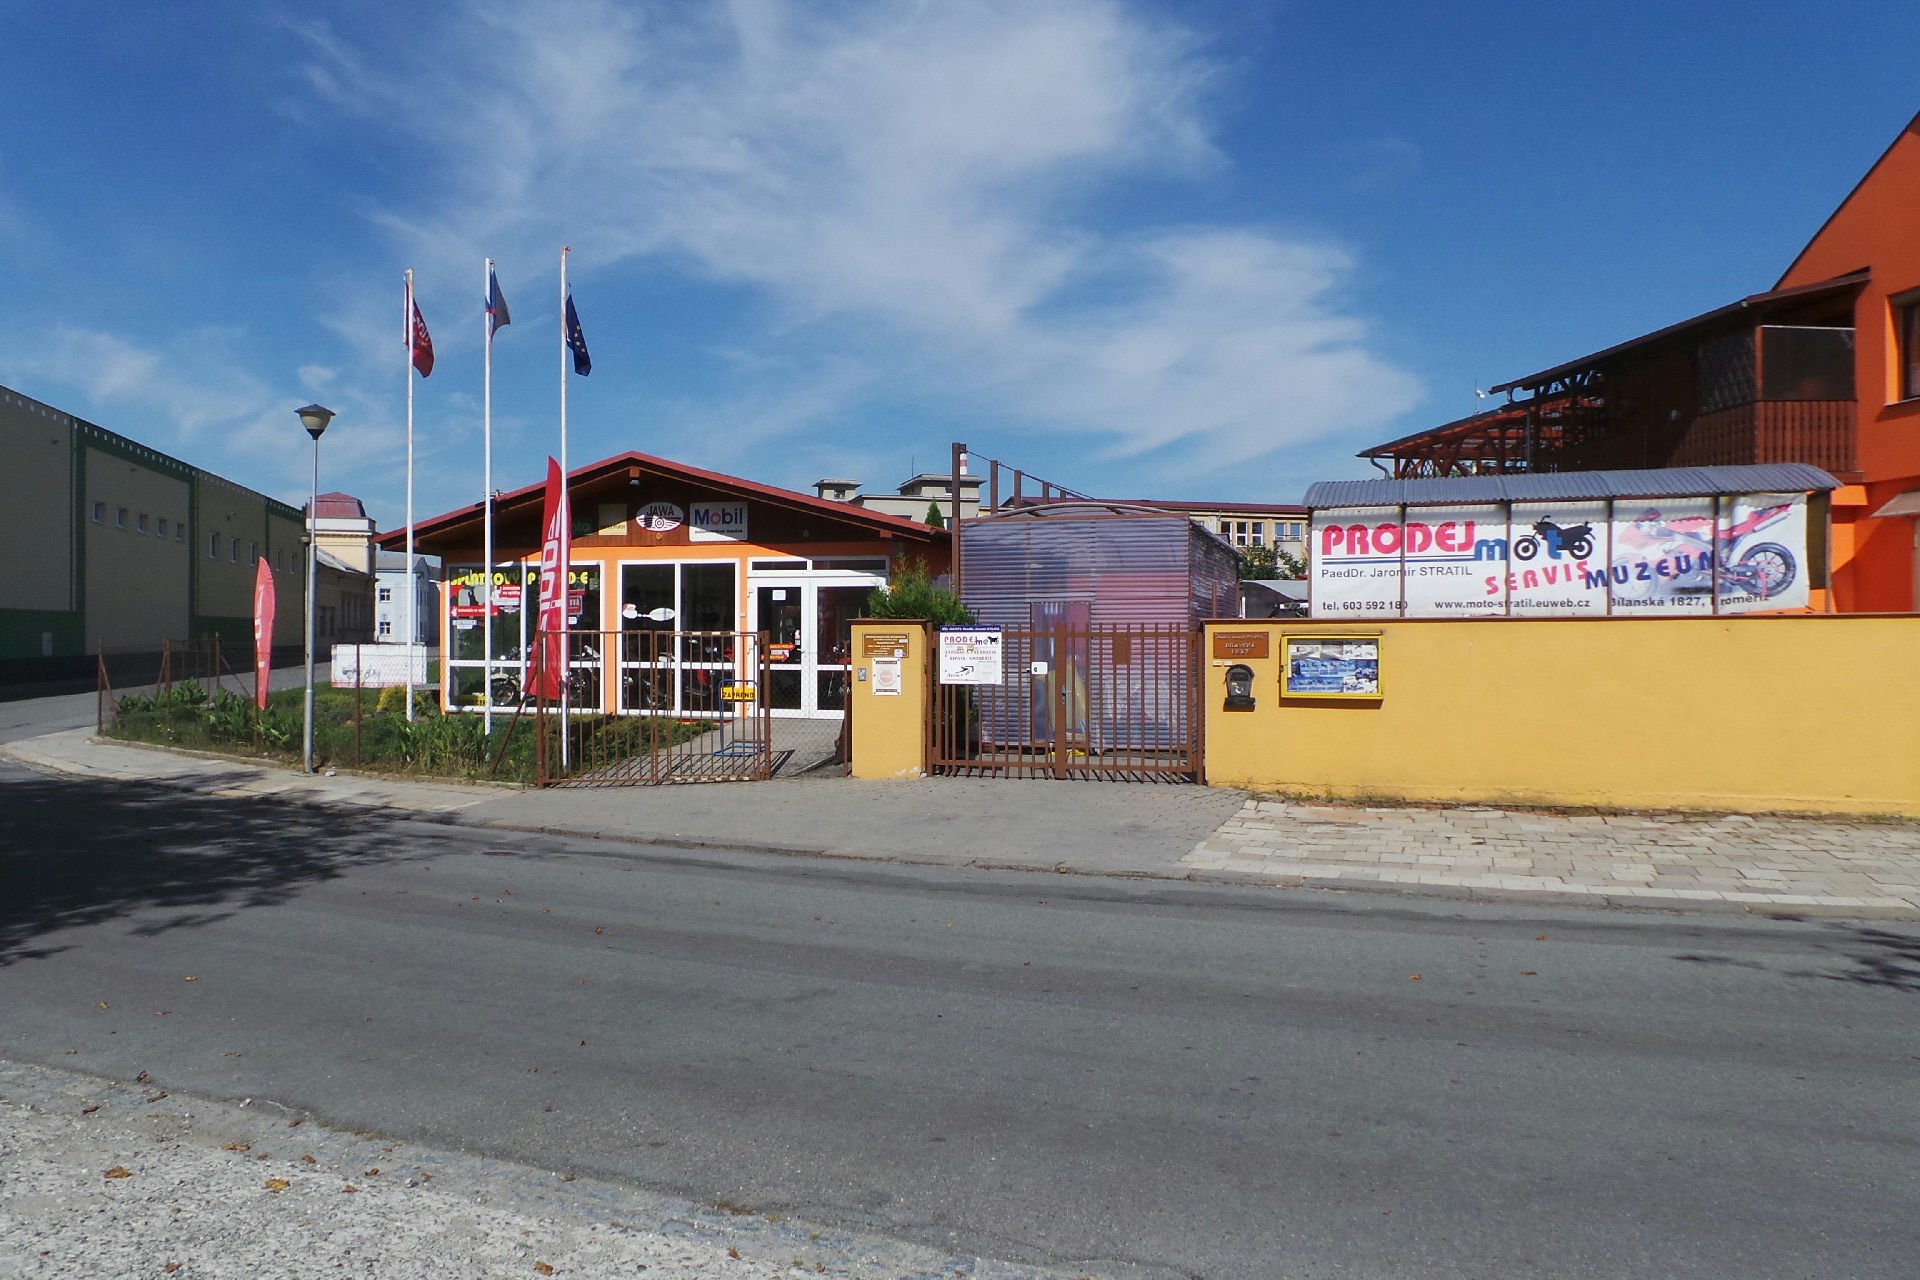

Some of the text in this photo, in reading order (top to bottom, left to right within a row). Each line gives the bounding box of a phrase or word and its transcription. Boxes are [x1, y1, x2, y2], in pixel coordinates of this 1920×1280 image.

[646, 505, 675, 516] JAWA
[694, 508, 743, 525] Mobil
[1321, 520, 1476, 556] PRODEJ
[1321, 568, 1366, 578] PaedDr.
[1419, 565, 1473, 576] STRATIL
[1485, 560, 1590, 595] SERVIS
[1322, 601, 1340, 610] tel.
[1342, 601, 1362, 610] 603
[1365, 600, 1385, 609] 592
